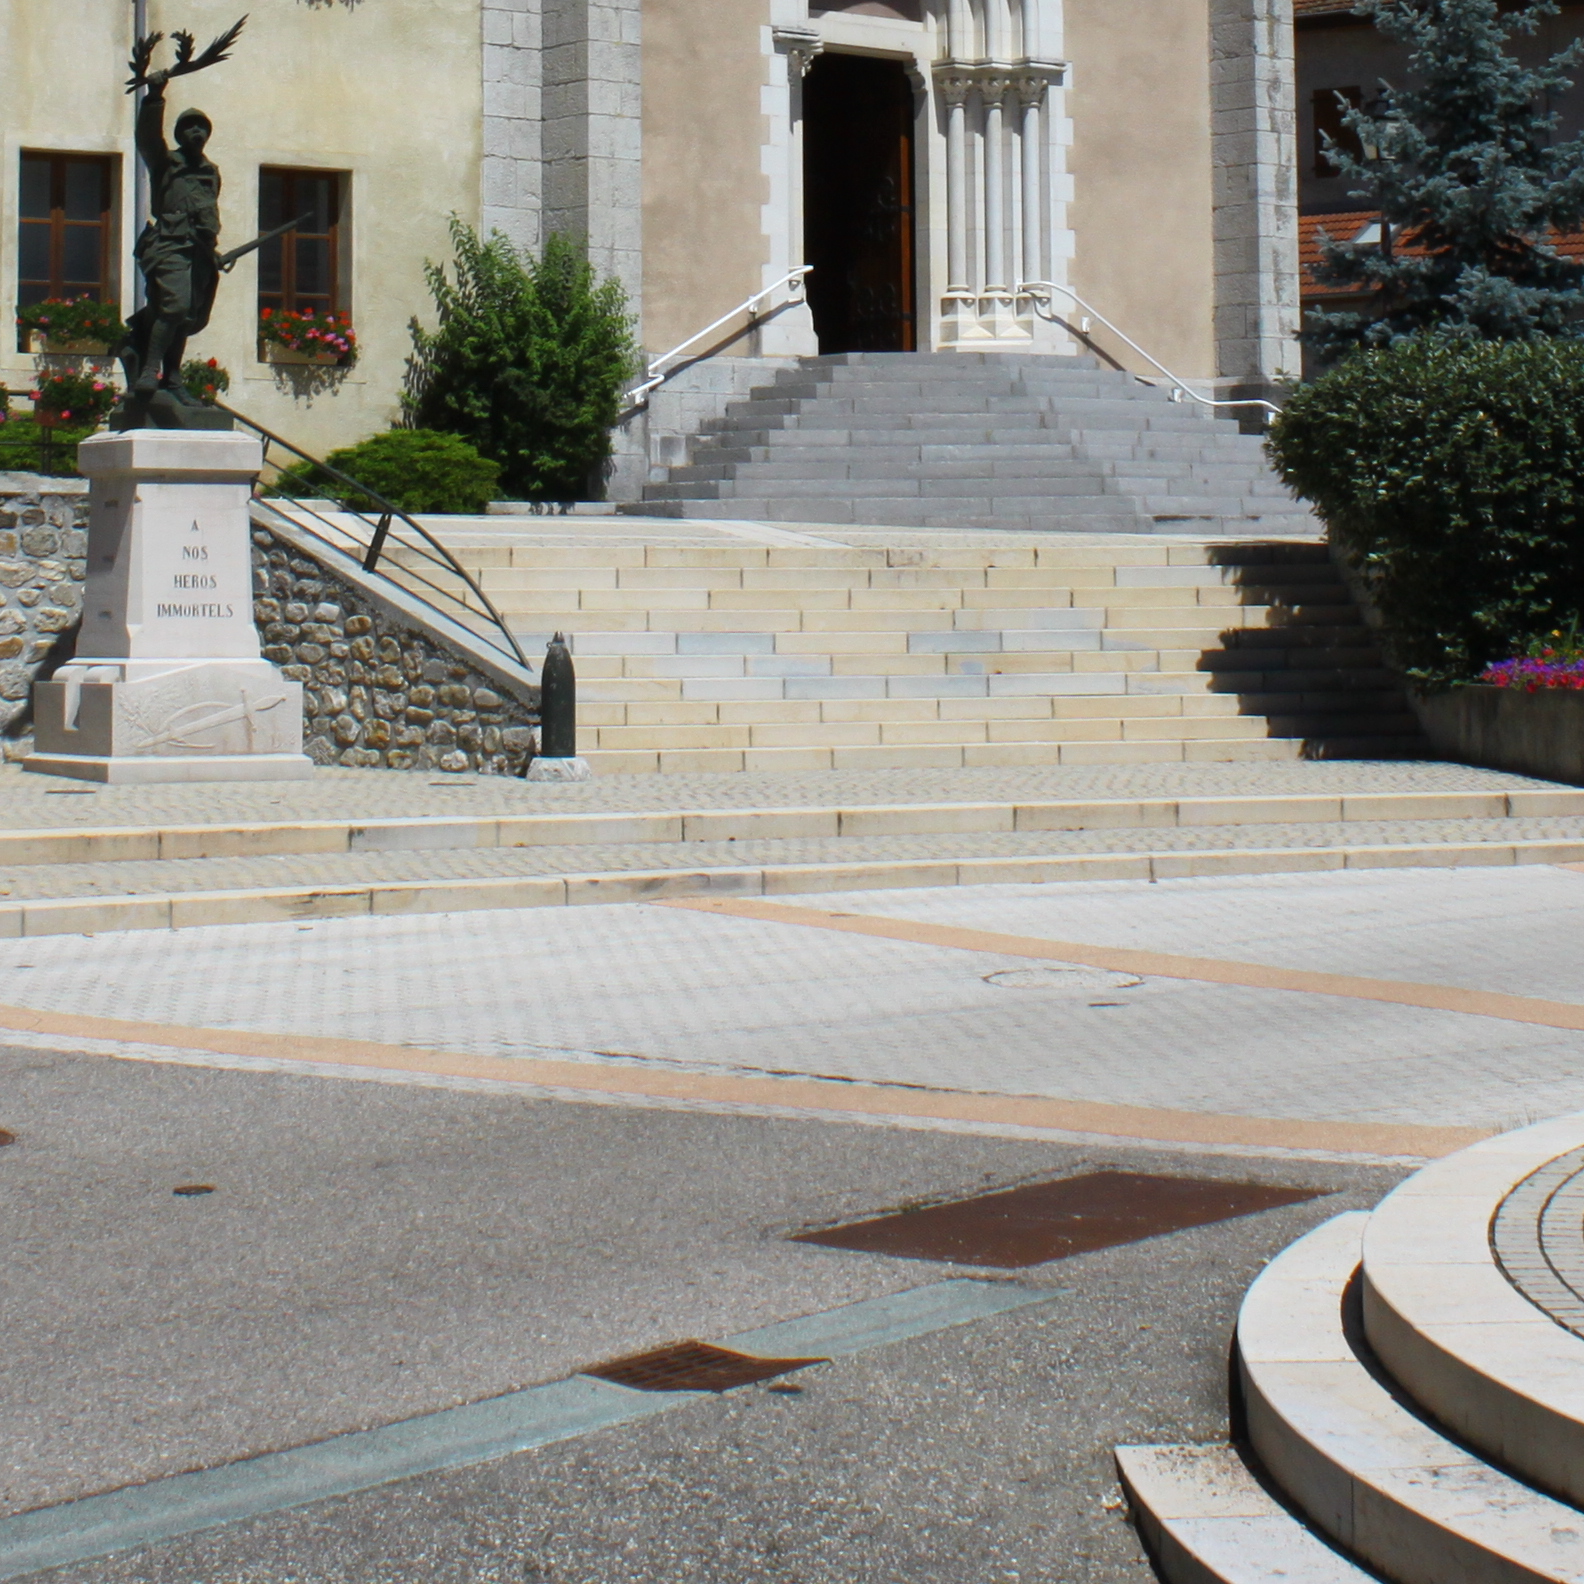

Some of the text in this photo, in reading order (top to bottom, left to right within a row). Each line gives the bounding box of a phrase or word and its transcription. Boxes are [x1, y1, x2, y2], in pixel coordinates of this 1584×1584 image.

[191, 520, 199, 531] A
[182, 545, 208, 560] NOS
[174, 574, 217, 589] HEROS
[157, 603, 234, 618] IMMORTELS
